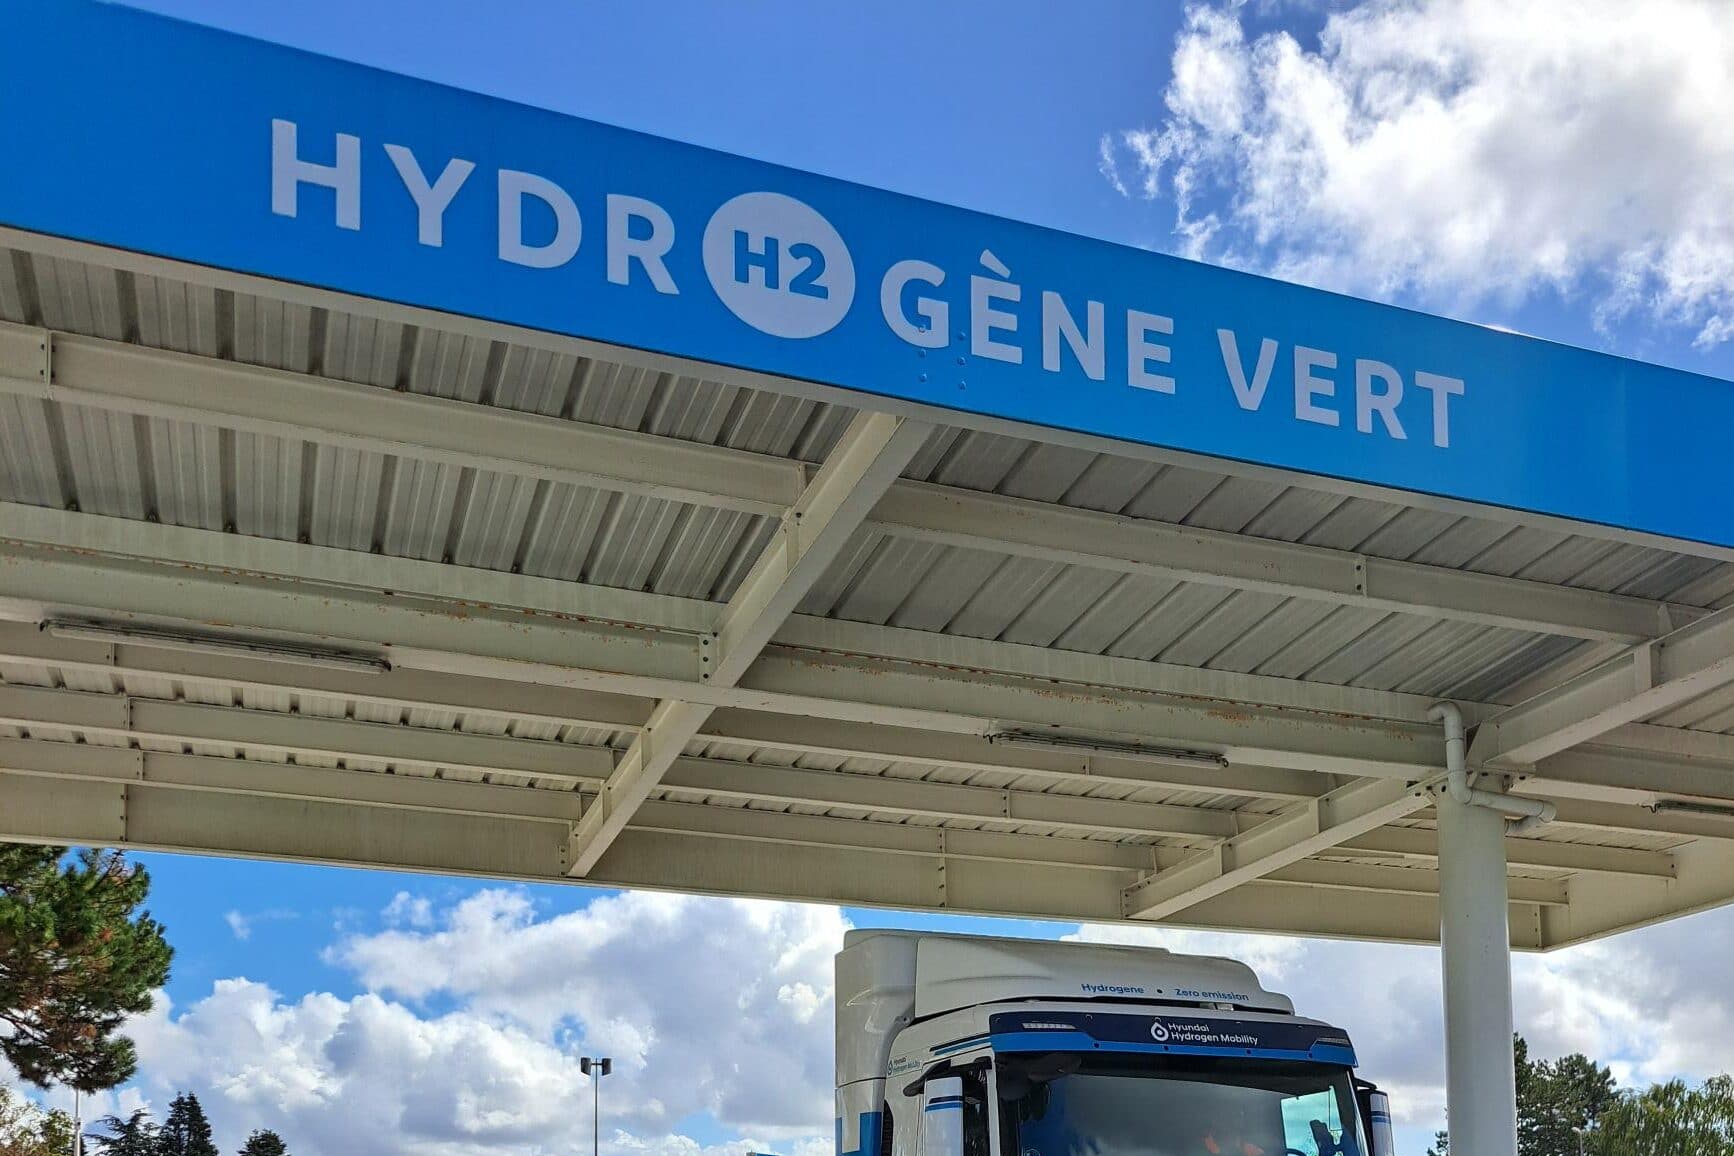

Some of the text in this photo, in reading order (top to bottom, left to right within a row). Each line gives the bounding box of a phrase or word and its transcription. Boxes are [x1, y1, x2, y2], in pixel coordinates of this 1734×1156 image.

[733, 230, 829, 300] H2
[1216, 328, 1465, 448] VERT
[1081, 983, 1249, 1001] Hydrogene Zero emission
[1168, 1022, 1210, 1034] Hyundai
[1171, 1031, 1258, 1046] Hydrogen Mobility
